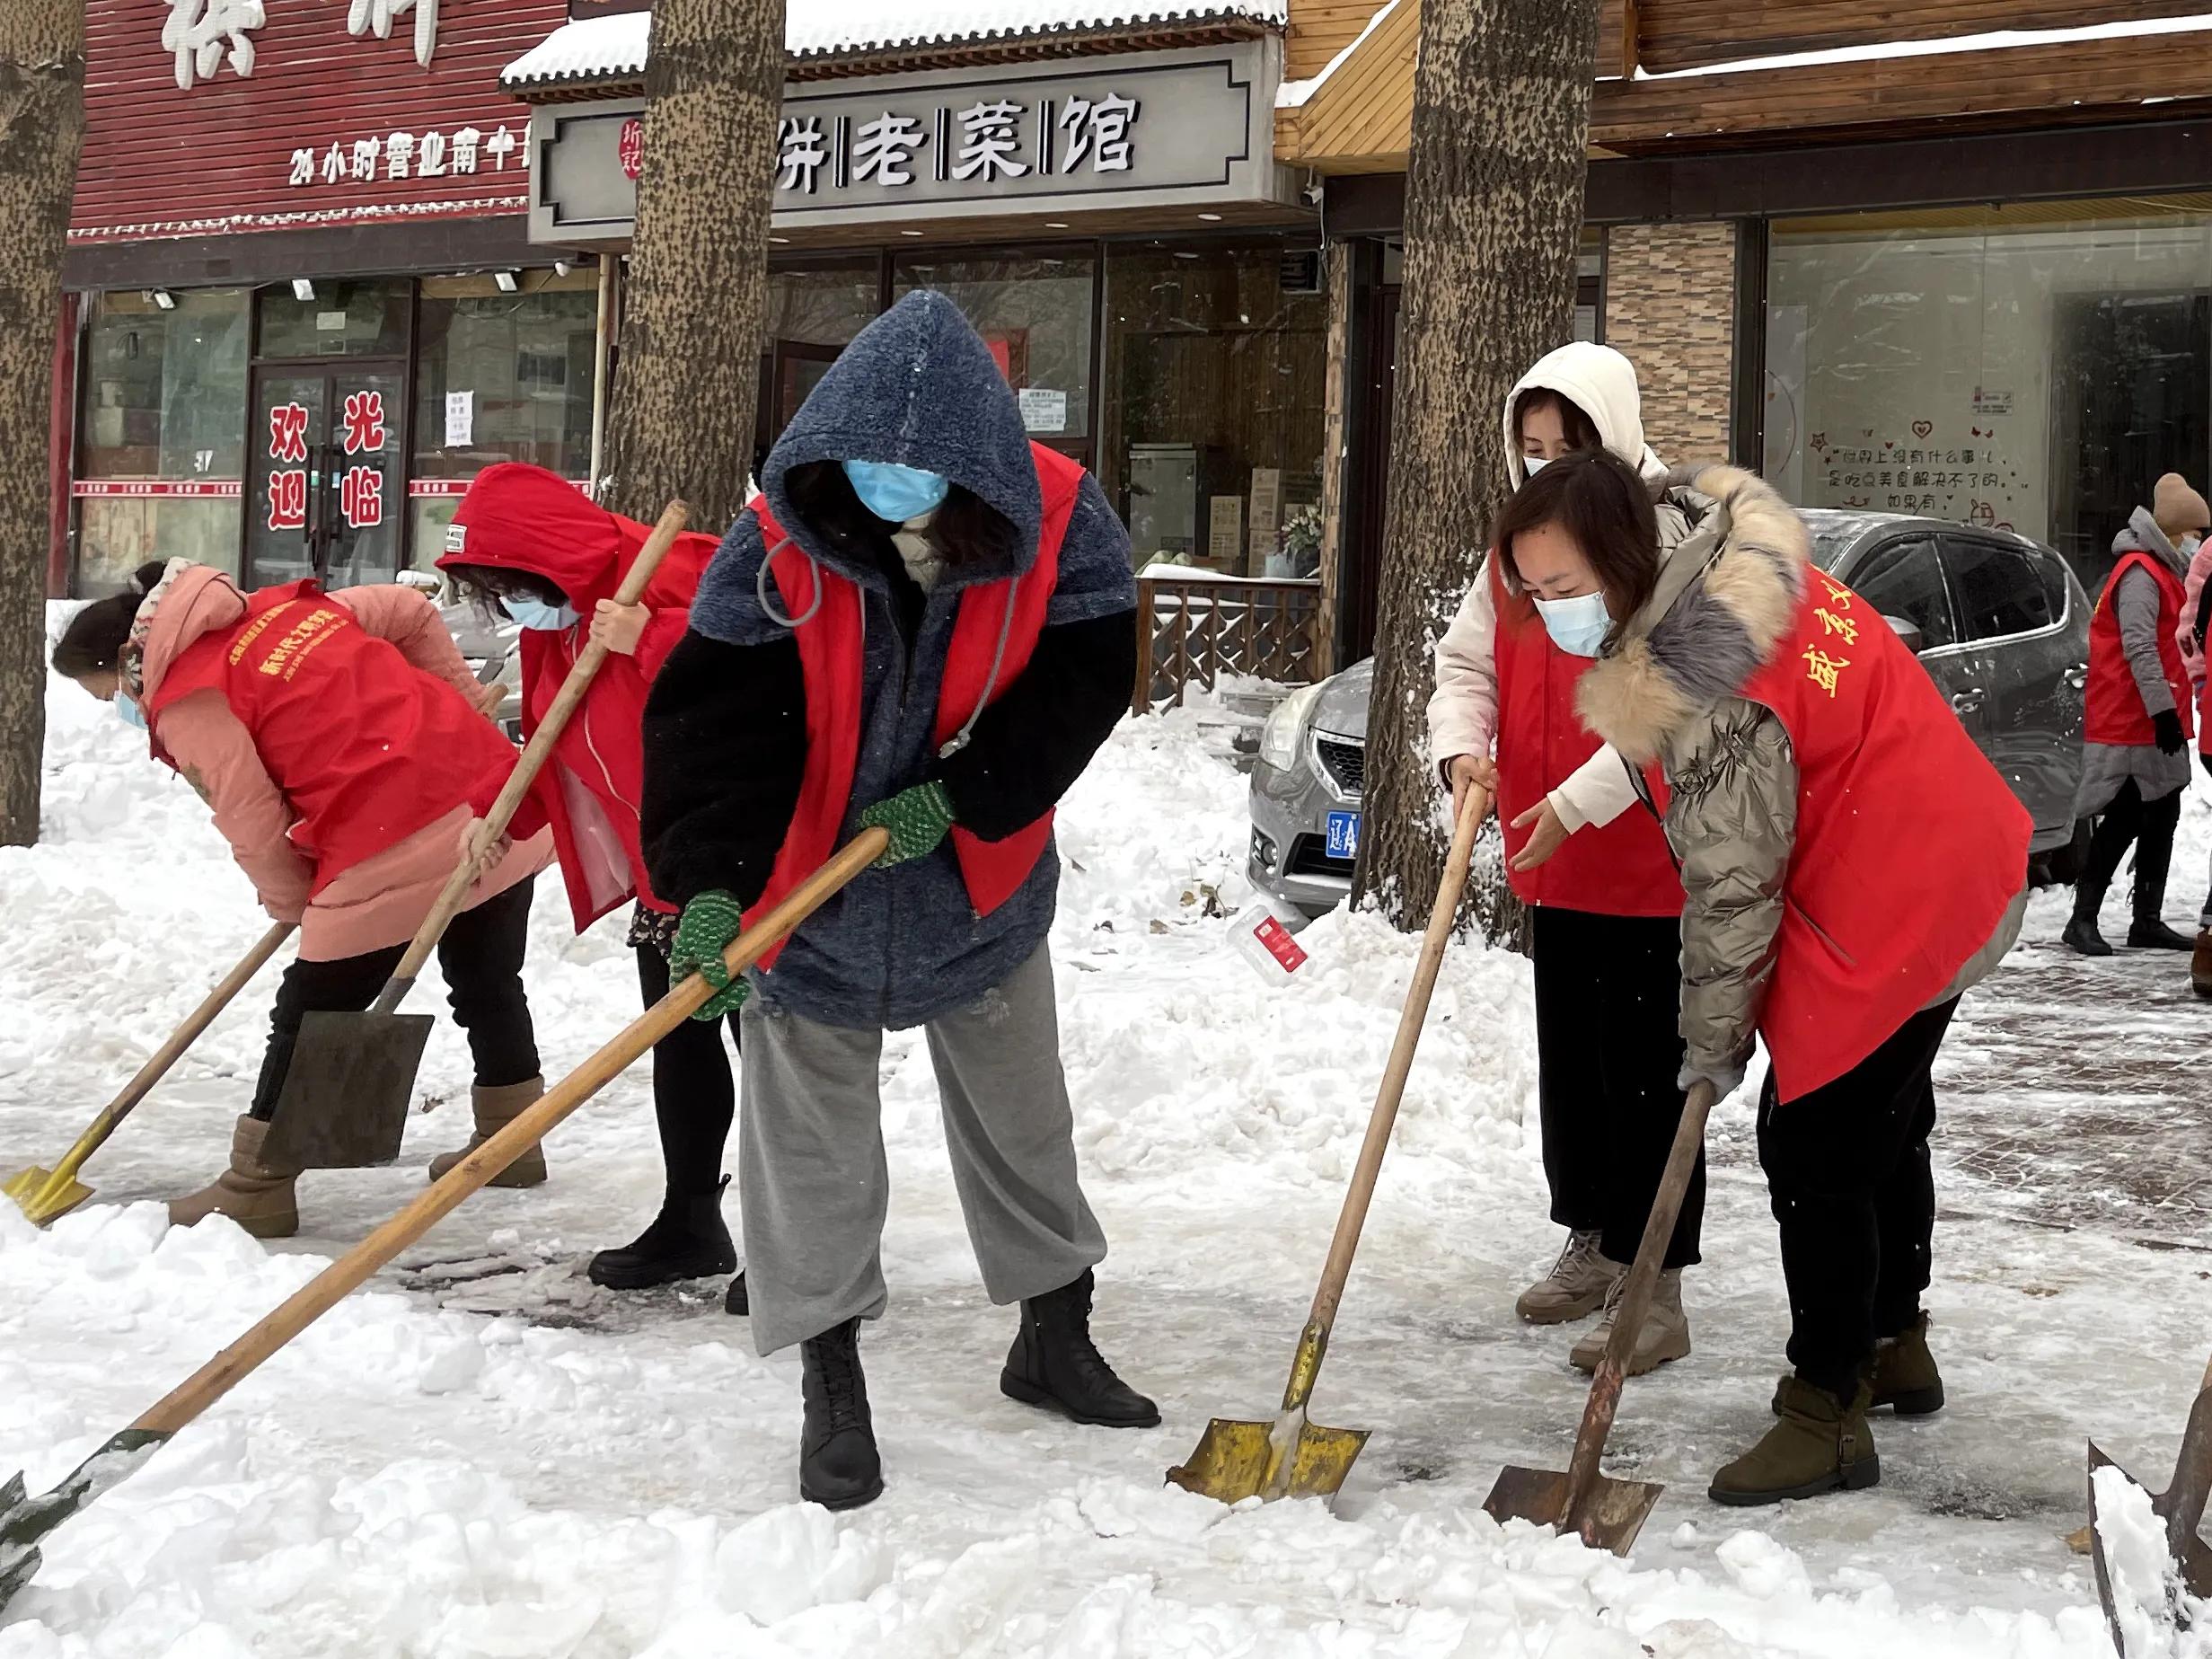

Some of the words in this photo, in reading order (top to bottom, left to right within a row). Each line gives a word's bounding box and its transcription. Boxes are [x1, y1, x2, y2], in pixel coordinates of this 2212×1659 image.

[289, 121, 532, 185] 24小时营业南十
[269, 402, 308, 531] 欢迎
[341, 391, 385, 528] 光临
[1329, 819, 1357, 851] 辽A
